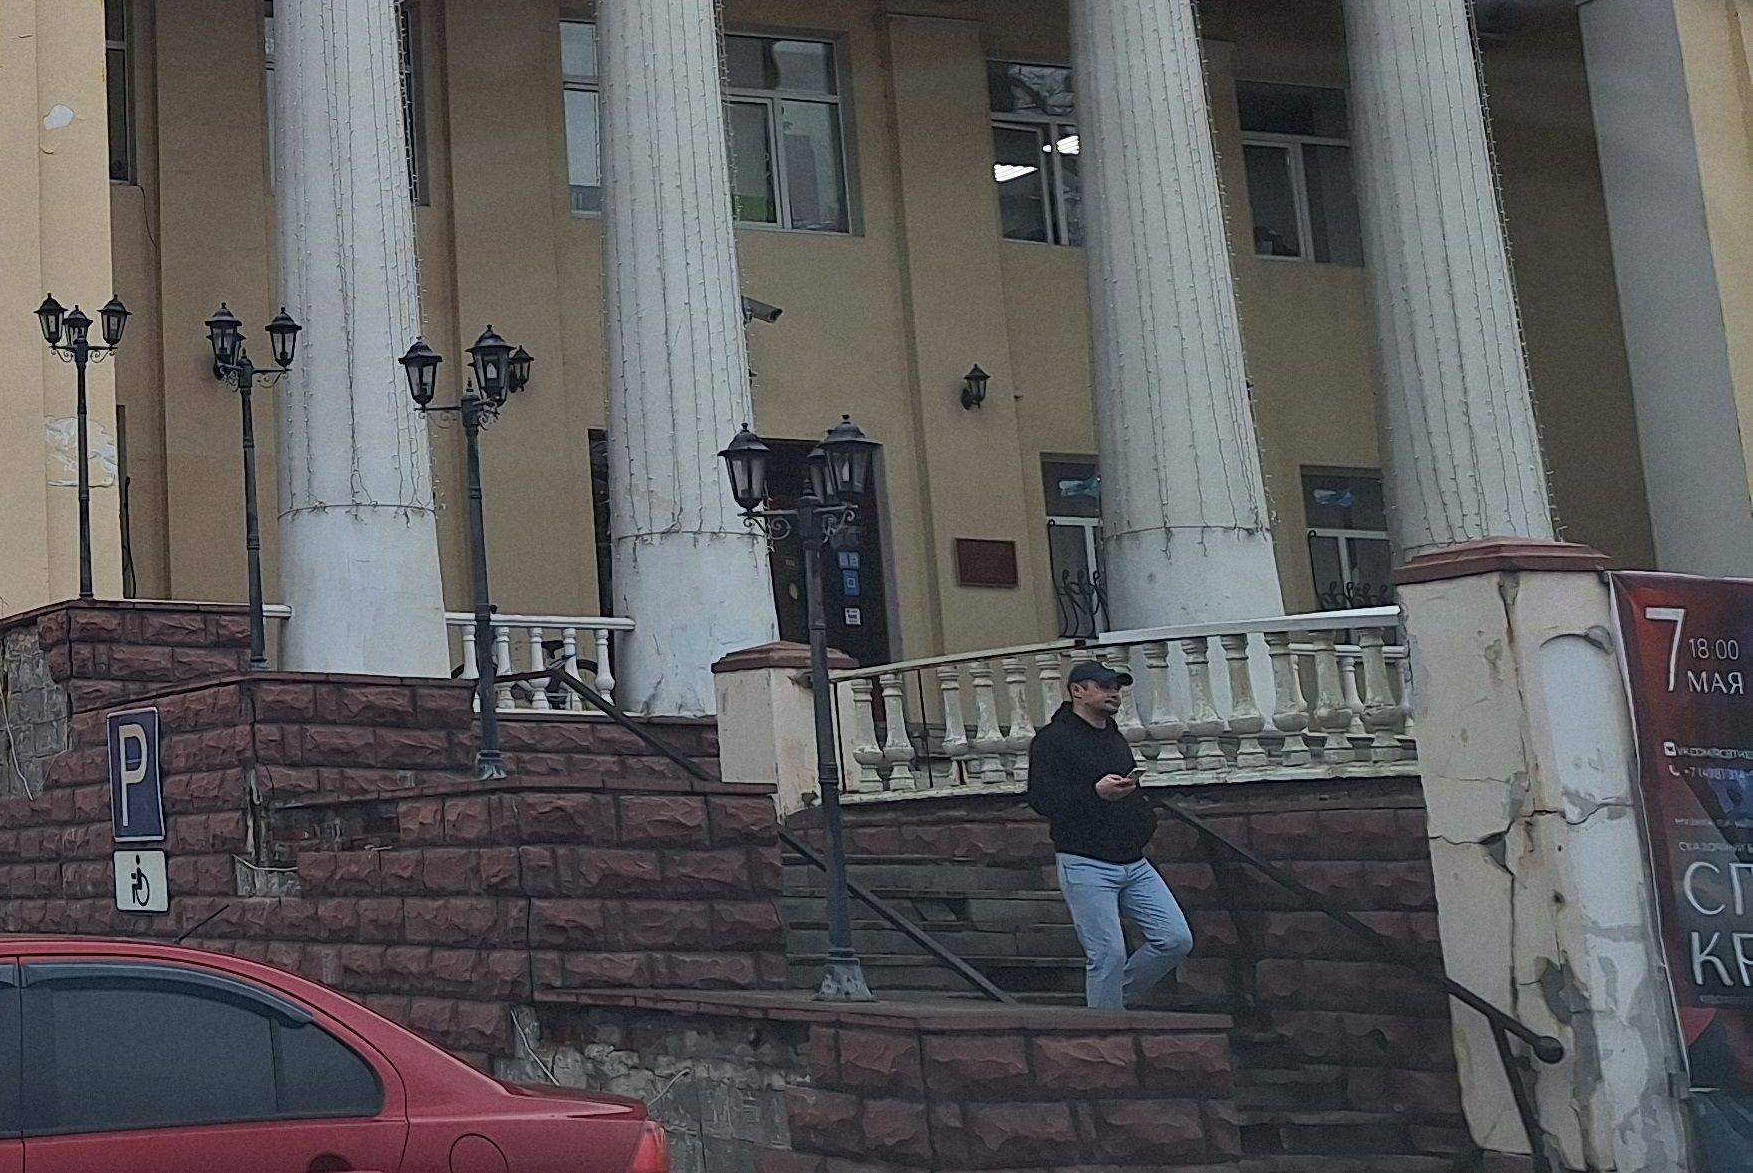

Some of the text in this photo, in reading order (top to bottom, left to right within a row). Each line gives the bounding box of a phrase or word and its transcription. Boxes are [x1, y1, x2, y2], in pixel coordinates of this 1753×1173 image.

[1645, 607, 1686, 692] 7
[1687, 670, 1745, 696] МАЯ
[118, 723, 148, 827] P
